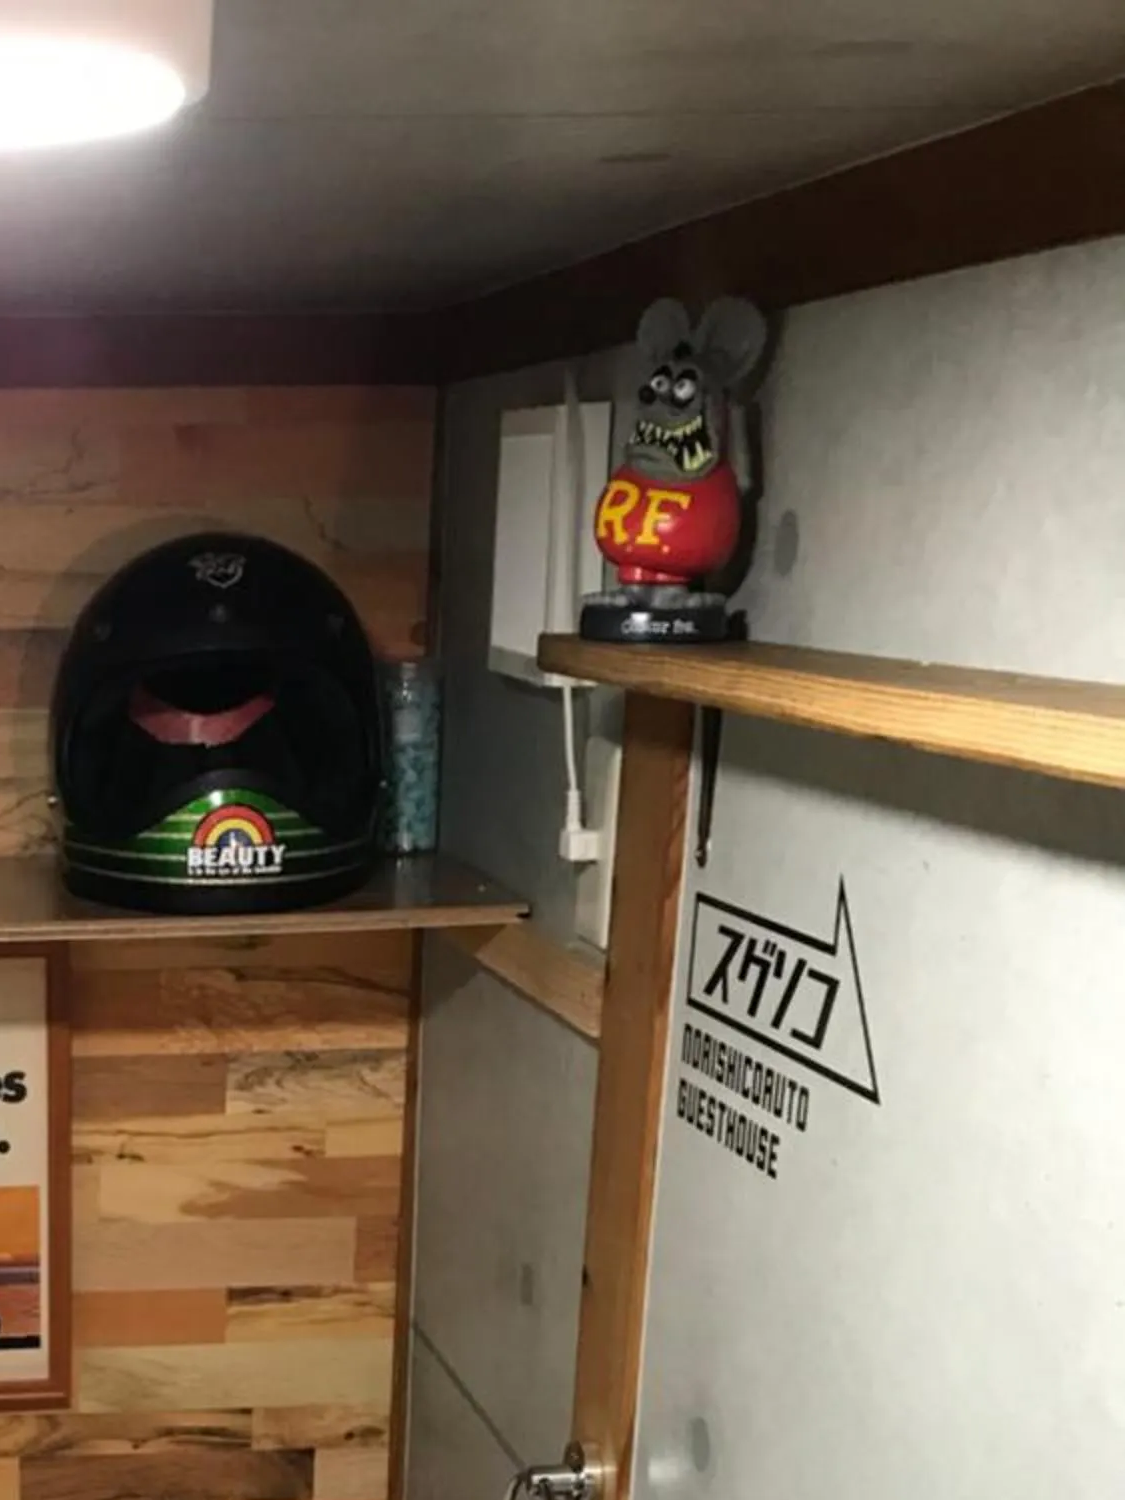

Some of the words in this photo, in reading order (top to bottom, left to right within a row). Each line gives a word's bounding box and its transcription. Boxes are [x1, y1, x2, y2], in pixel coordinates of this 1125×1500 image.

[187, 845, 287, 866] BEAUTY
[703, 923, 841, 1051] スグソコ
[676, 1077, 781, 1180] GUESTHOUSE
